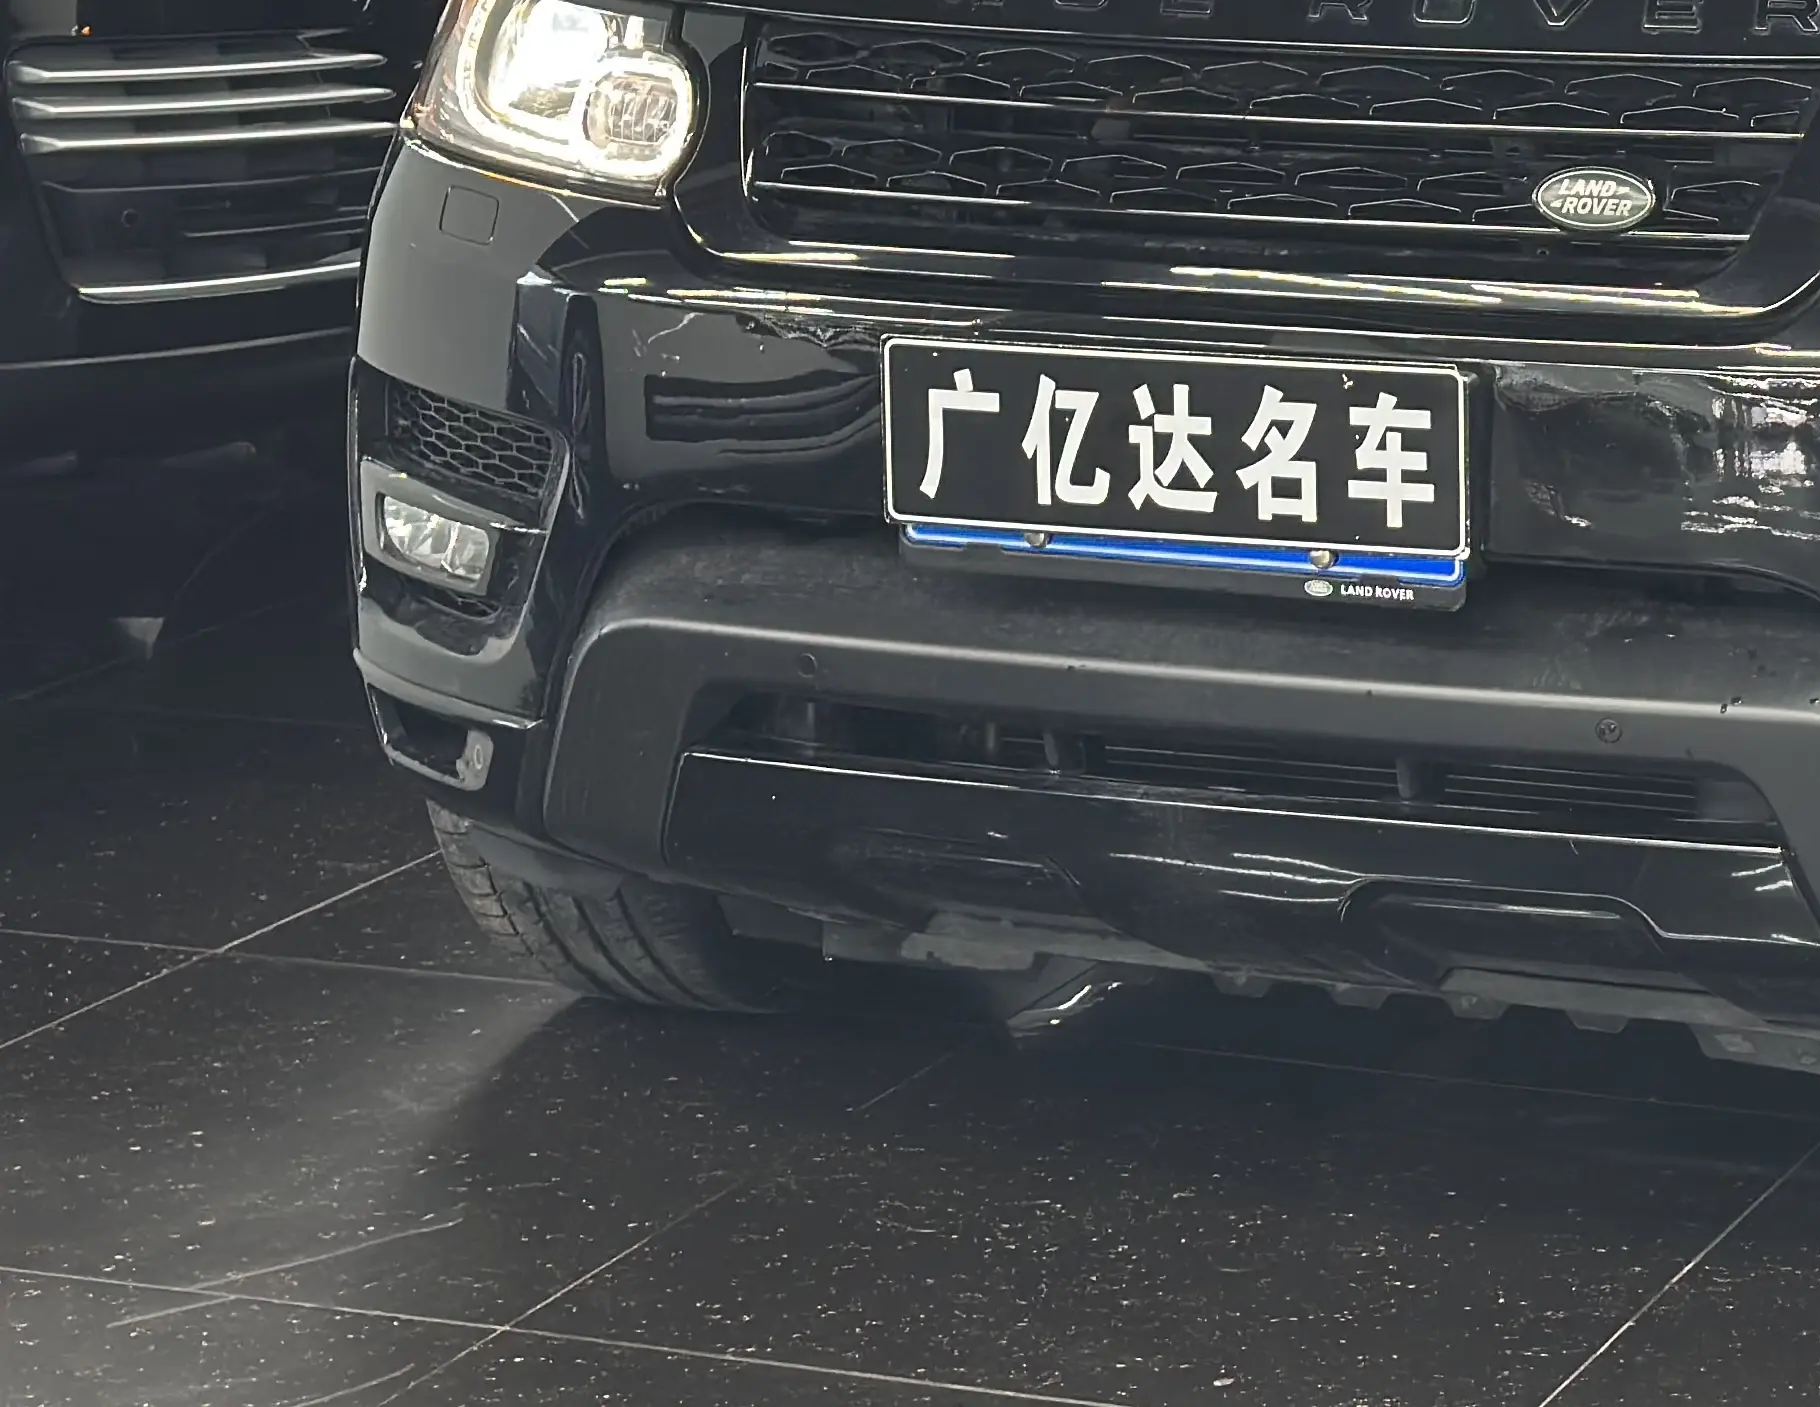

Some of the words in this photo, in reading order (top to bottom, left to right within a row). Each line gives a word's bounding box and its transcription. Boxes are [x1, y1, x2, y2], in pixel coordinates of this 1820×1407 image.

[1557, 178, 1618, 197] LAND
[1561, 197, 1633, 217] ROVER
[919, 367, 1435, 528] 广亿达名车
[1340, 584, 1374, 597] LAND
[1375, 585, 1415, 601] ROVER
